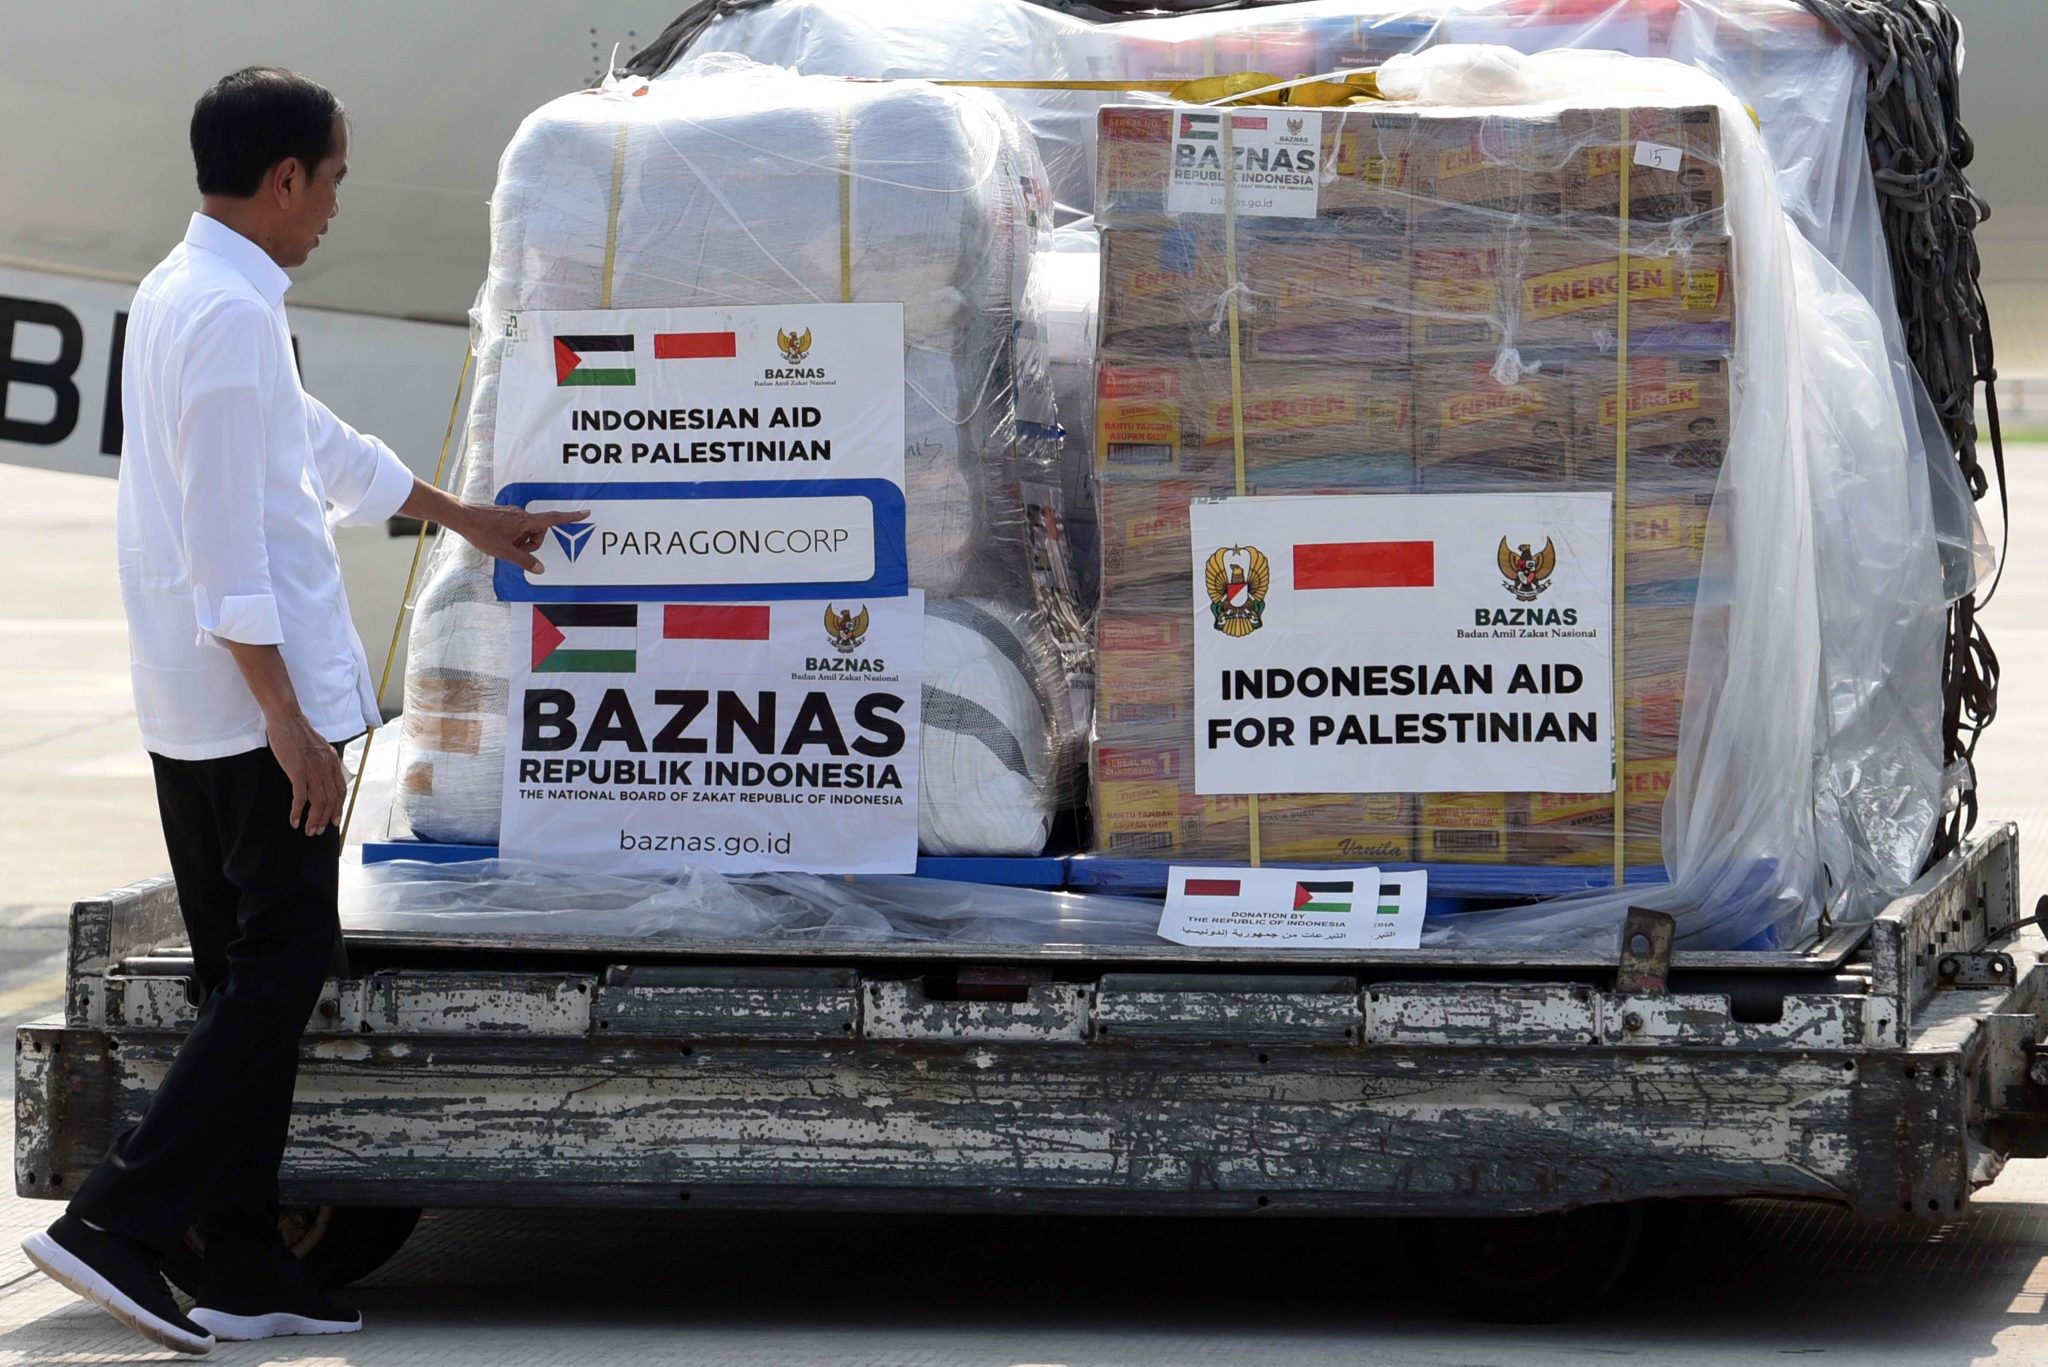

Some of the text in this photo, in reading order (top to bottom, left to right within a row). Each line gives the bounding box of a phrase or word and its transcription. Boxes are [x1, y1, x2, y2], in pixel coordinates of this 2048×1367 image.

[1241, 174, 1314, 185] INDONESIA
[765, 368, 825, 379] BAZNAS
[572, 407, 821, 431] INDONESIAN AID
[562, 440, 831, 464] FOR PALESTINIAN
[601, 528, 849, 555] PARAGONCORP
[1475, 608, 1578, 626] BAZNAS
[1456, 628, 1596, 638] Badan Amil Zakat Nasional
[805, 657, 885, 672] BAZNAS
[863, 674, 899, 682] Nasional
[1221, 663, 1583, 701] INDONESIAN AID
[521, 688, 906, 758] BAZNAS
[1208, 711, 1598, 749] FOR PALESTINIAN
[519, 759, 903, 789] REPUBLIK INDONESIA
[519, 789, 904, 805] THE NATIONAL BOARD OF ZAKAT REPUBLIC OF INDONESIA
[620, 830, 792, 856] baznas.go.id
[1338, 837, 1402, 857] Vanila
[1211, 917, 1267, 926] REPUBLIC
[1269, 918, 1283, 926] OF
[1286, 920, 1346, 928] INDONESIA
[1231, 911, 1306, 920] DONATION BY
